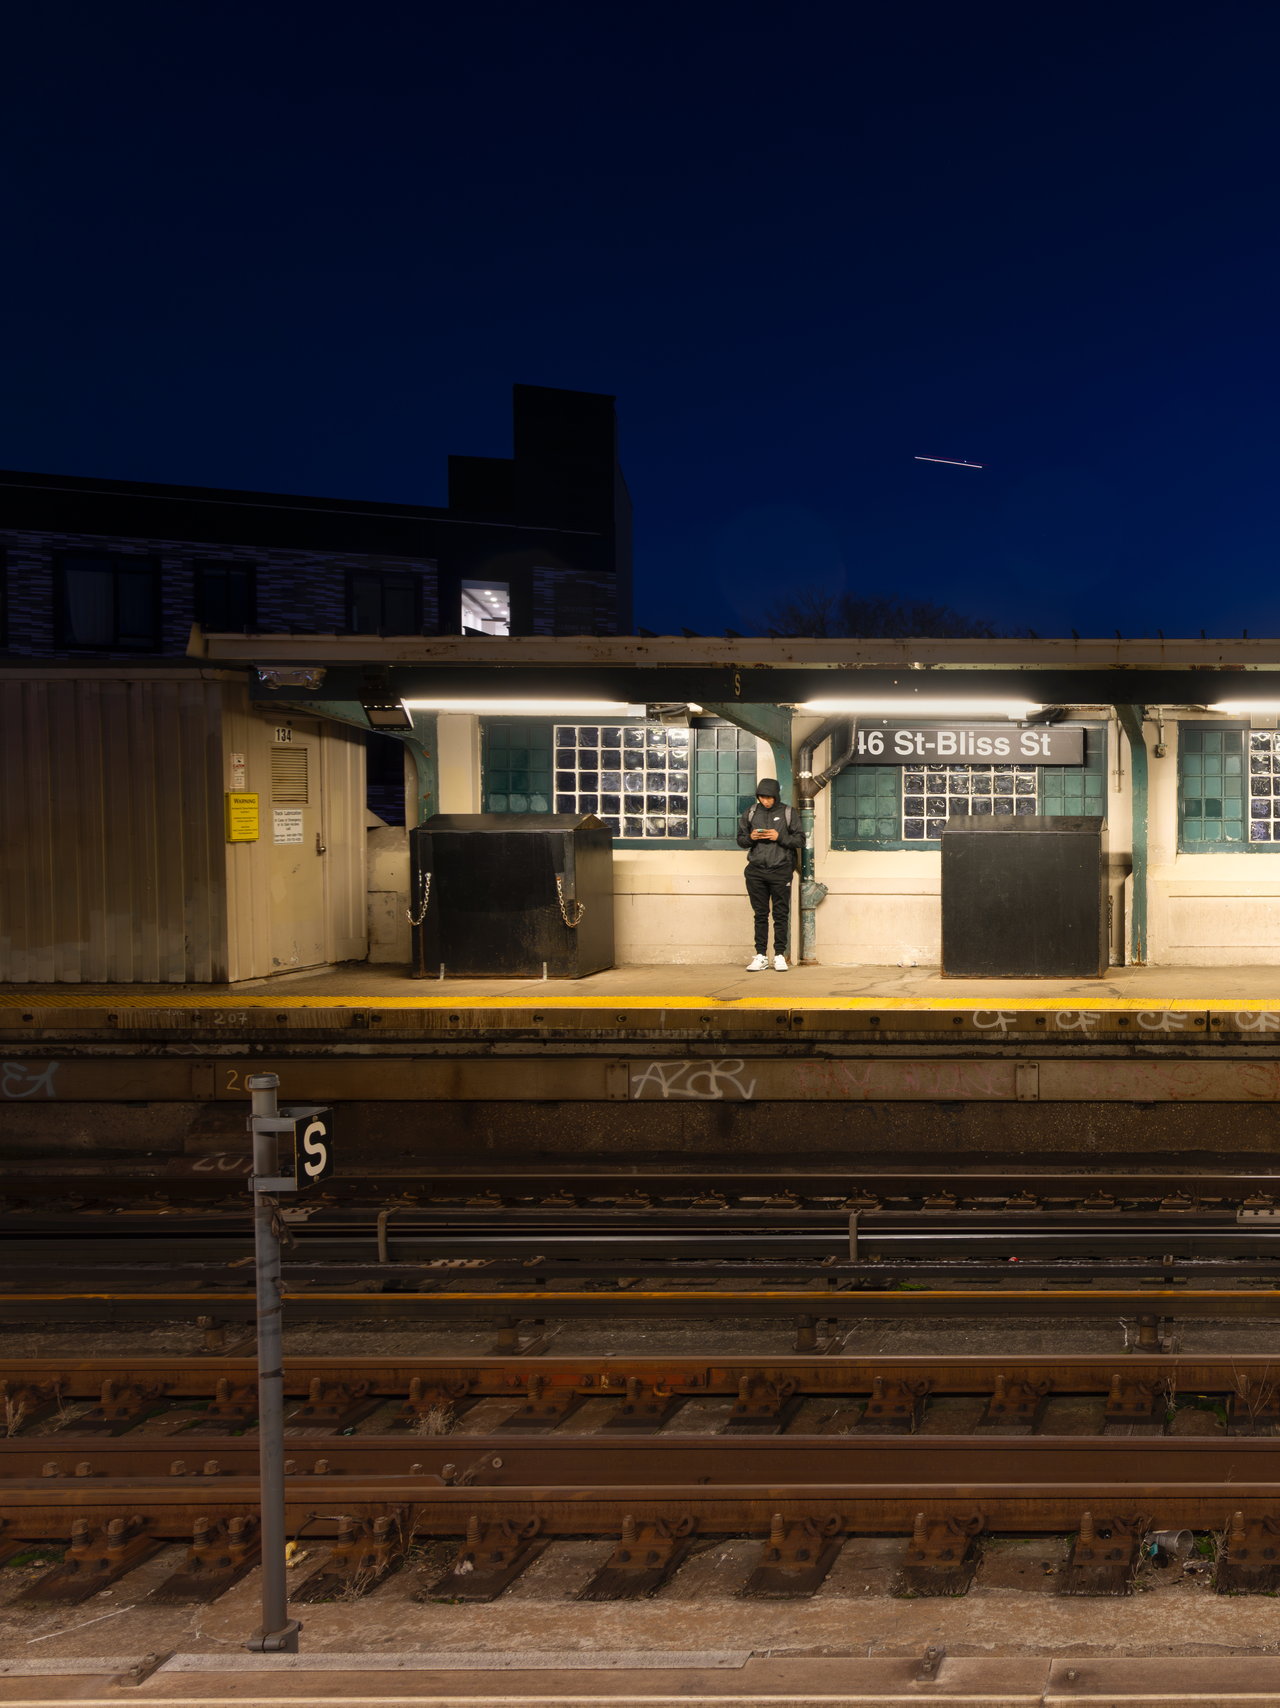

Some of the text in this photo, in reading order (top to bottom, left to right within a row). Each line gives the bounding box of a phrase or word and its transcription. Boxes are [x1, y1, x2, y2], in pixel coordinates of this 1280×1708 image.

[734, 673, 741, 696] S
[277, 728, 292, 742] 134
[894, 730, 1010, 756] St-Bliss
[1020, 731, 1051, 756] St
[214, 1012, 248, 1025] 207
[303, 1120, 328, 1177] S
